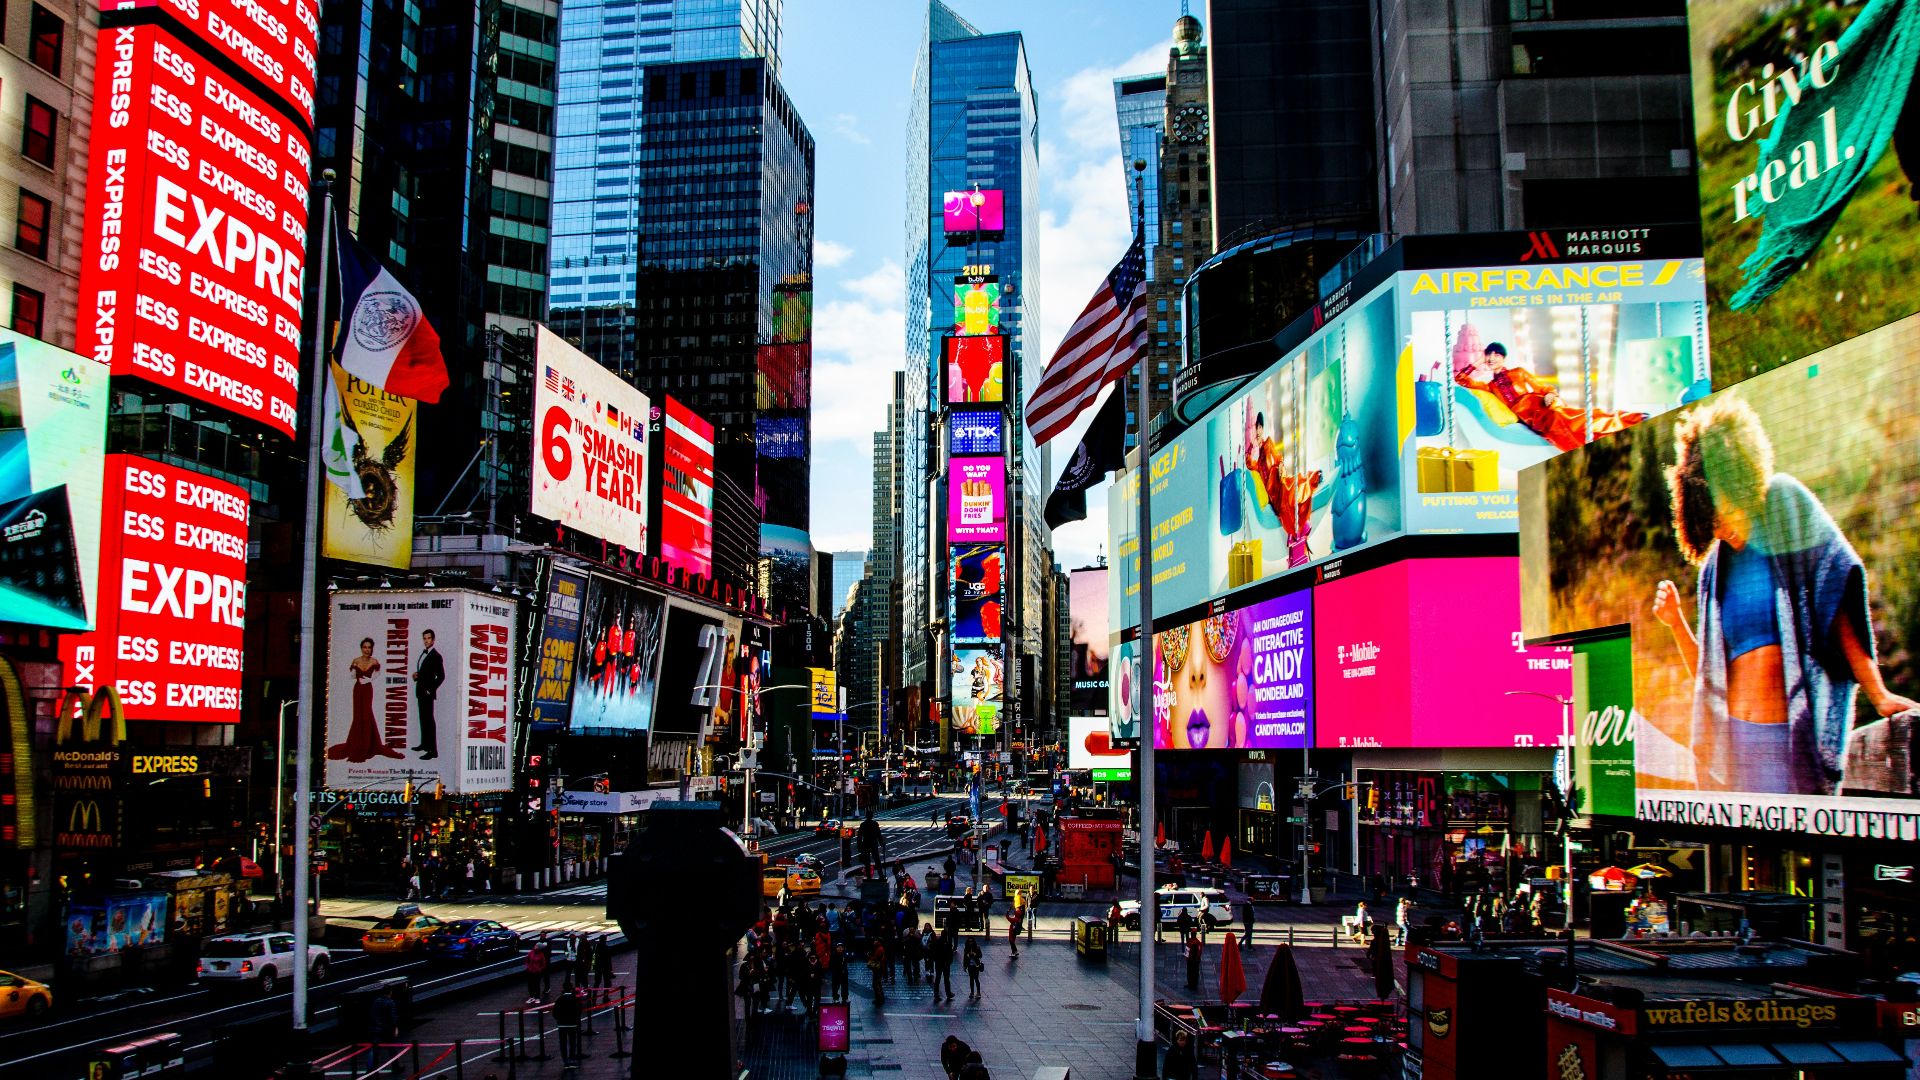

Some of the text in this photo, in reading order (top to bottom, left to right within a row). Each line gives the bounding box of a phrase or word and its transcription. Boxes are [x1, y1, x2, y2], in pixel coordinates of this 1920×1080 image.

[208, 11, 284, 84] EXPRESS
[1726, 40, 1840, 142] Give
[204, 76, 280, 145] EXPRESS
[200, 115, 278, 180] EXPRESS
[1731, 106, 1856, 224] real.
[199, 159, 276, 222] EXPRESS
[99, 148, 126, 271] EXPRESS
[154, 175, 305, 320] EXPRE
[1567, 228, 1651, 242] MARRIOTT
[1567, 242, 1642, 256] MARQUIS
[963, 264, 991, 276] 2018
[1410, 264, 1644, 295] AIRFRANCE
[190, 272, 268, 327] EXPRESS
[1324, 282, 1352, 308] MARRIOTT
[1324, 297, 1349, 321] MARQUIS
[1471, 292, 1623, 307] FRANCE IS IN THE AIR
[189, 316, 267, 368] EXPRESS
[184, 361, 263, 410] EXPRESS
[542, 405, 583, 481] 6 TH
[964, 427, 997, 438] TDK
[125, 466, 166, 499] ESS
[176, 480, 245, 522] EXPRESS
[1423, 494, 1510, 507] PUTTING YOU
[123, 510, 165, 541] ESS
[175, 522, 244, 560] EXPRESS
[1159, 519, 1170, 537] THE
[1171, 506, 1193, 532] CENTER
[121, 558, 246, 630] EXPRE
[1253, 610, 1304, 633] AN OUTRAGEOUSLY
[117, 635, 159, 663] ESS
[170, 641, 239, 672] EXPRESS
[385, 618, 409, 674] PRETTY
[543, 637, 575, 661] COME
[1253, 628, 1304, 654] INTERACTIVE
[1253, 648, 1304, 685] CANDY
[1527, 659, 1572, 670] THE UN-
[167, 683, 237, 710] EXPRESS
[467, 624, 489, 739] WOMAN
[487, 624, 509, 744] PRETTY
[537, 679, 570, 701] AWAY
[1075, 681, 1097, 689] MUSIC
[1255, 683, 1304, 702] WONDERLAND
[384, 685, 408, 749] WOMAN
[1255, 722, 1305, 736] CANDYTOPIA.COM
[54, 751, 120, 762] McDonald's
[132, 755, 199, 774] EXPRESS
[467, 746, 506, 770] THE MUSICAL
[1636, 800, 1733, 827] AMERICAN
[1739, 805, 1808, 834] EAGLE
